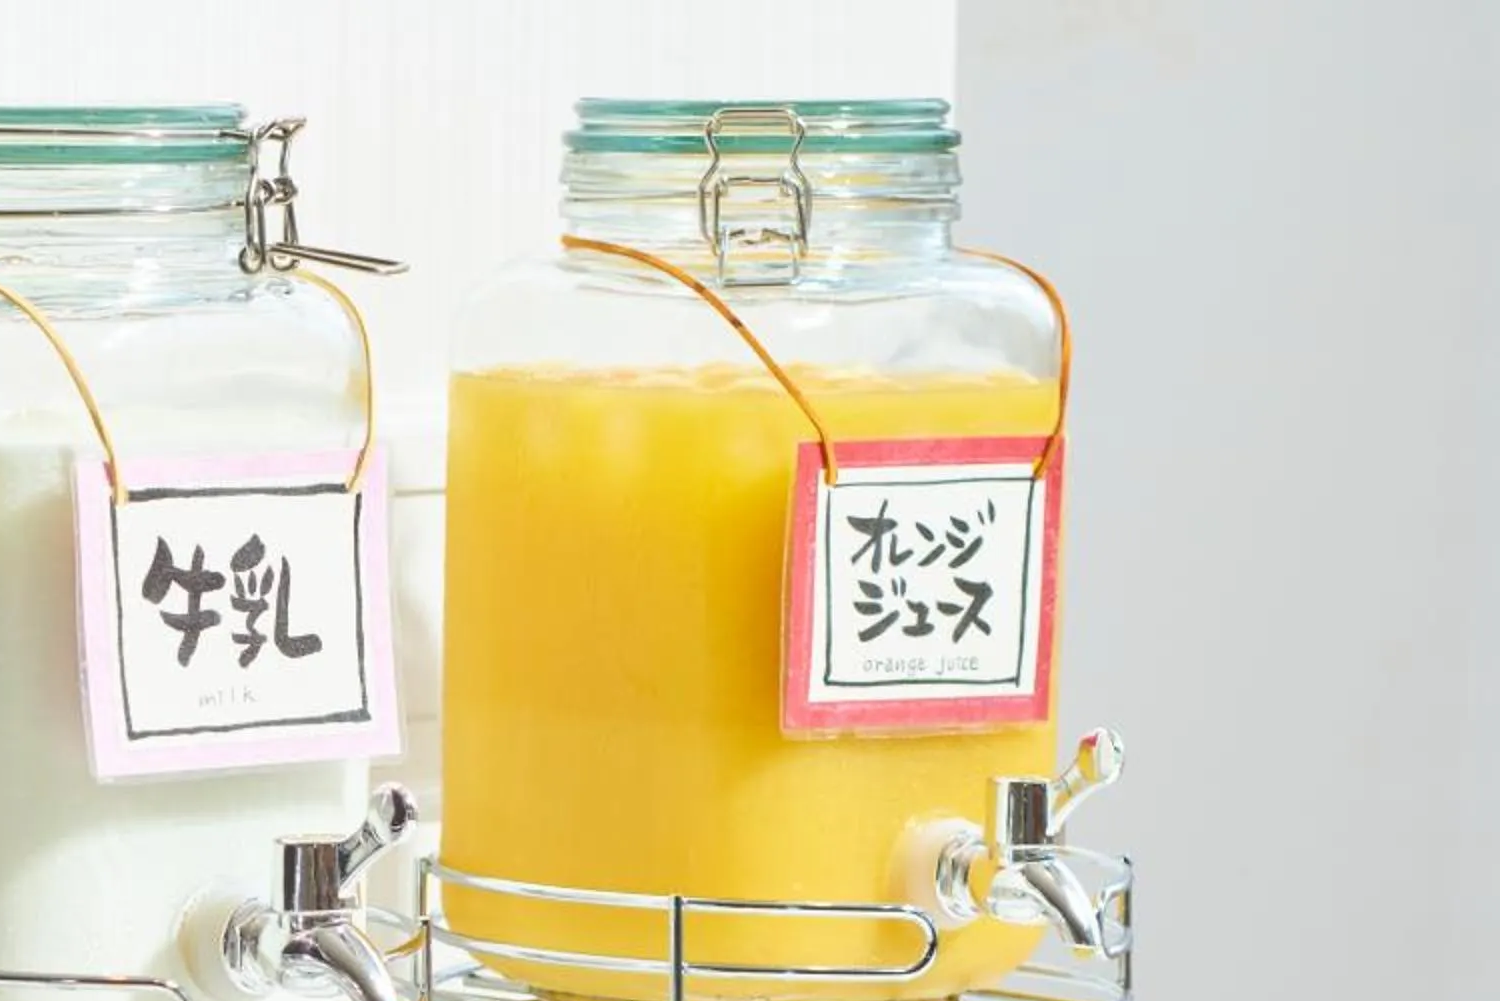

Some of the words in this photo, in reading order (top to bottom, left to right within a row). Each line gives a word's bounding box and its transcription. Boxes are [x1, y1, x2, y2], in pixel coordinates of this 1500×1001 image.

[846, 498, 996, 573] オレンジ
[141, 532, 323, 669] 牛乳
[853, 576, 993, 644] ジュース
[198, 686, 258, 708] milk
[862, 658, 928, 676] orange
[937, 655, 979, 675] juice
